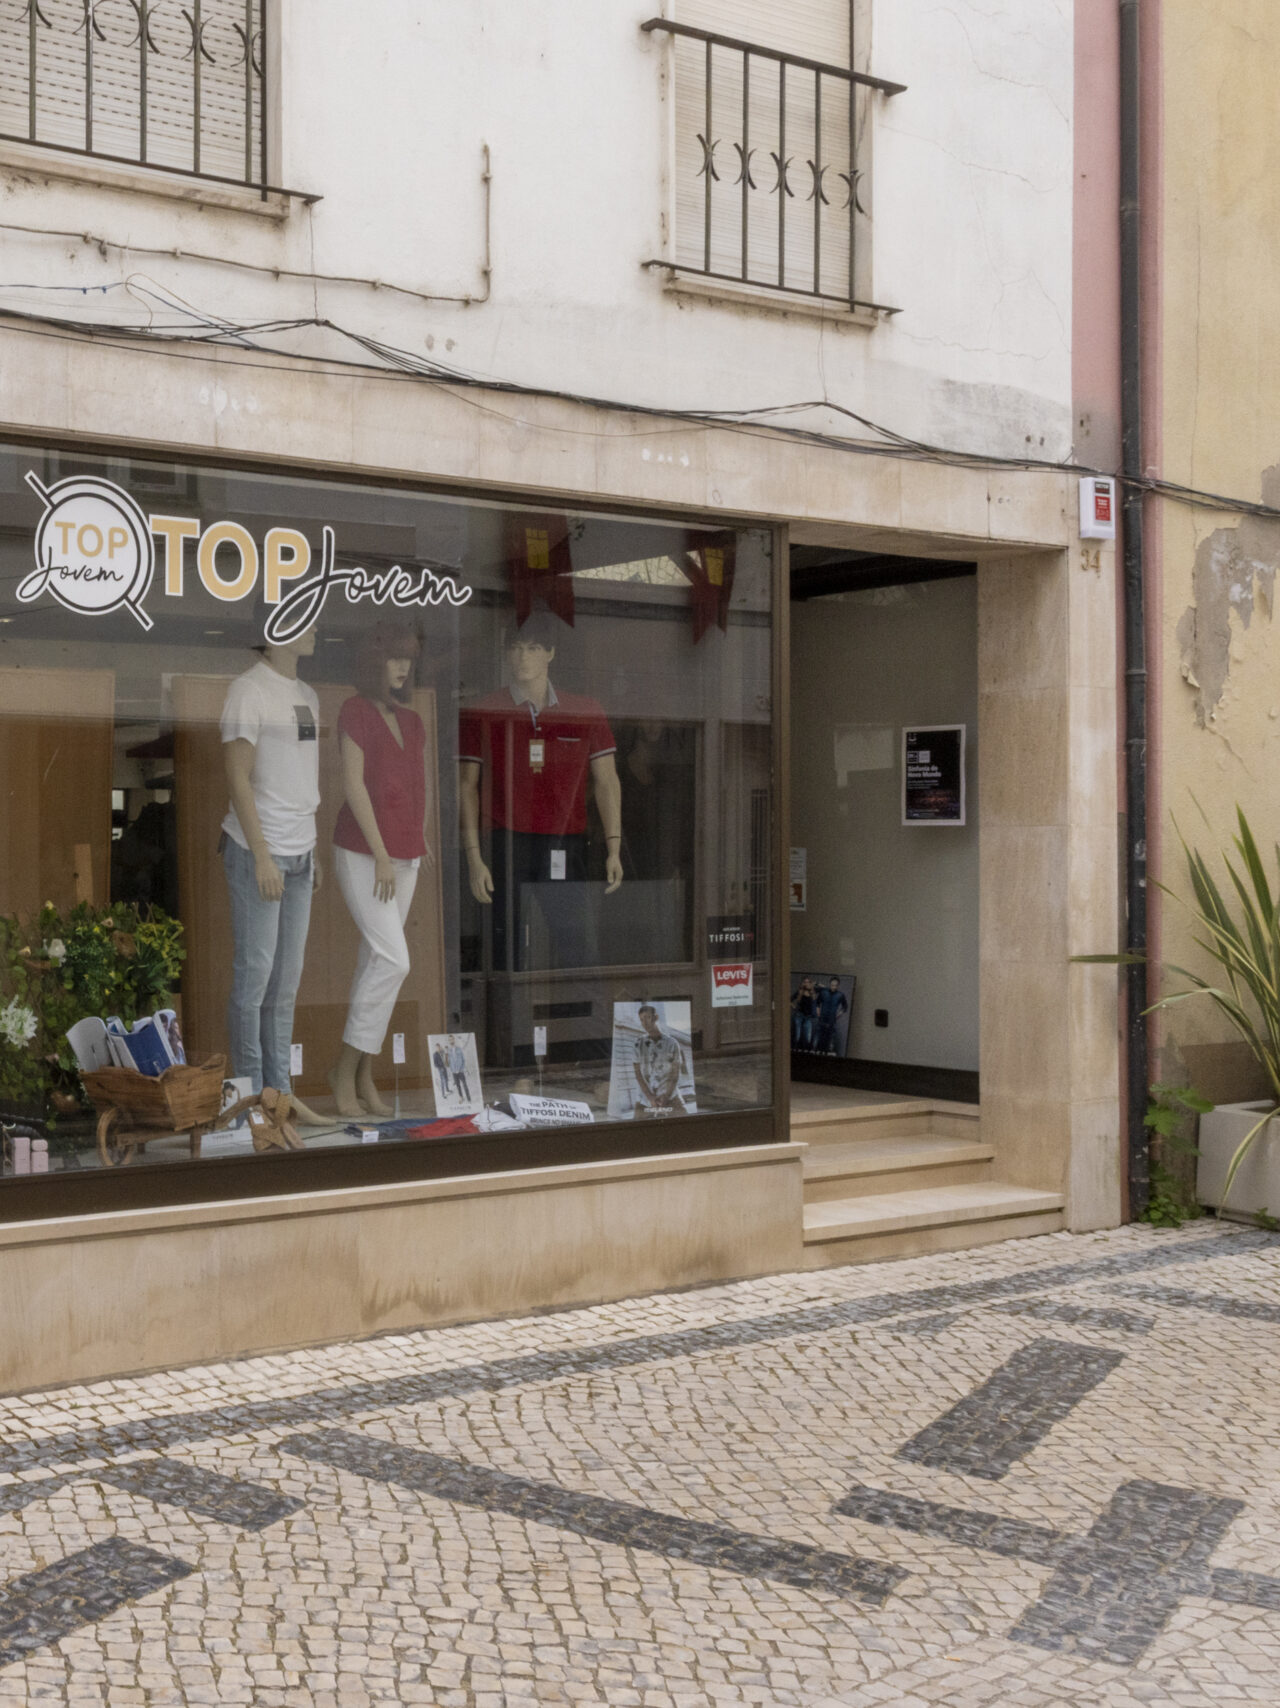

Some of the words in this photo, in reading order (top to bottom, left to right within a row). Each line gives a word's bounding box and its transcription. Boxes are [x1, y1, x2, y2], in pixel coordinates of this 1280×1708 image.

[54, 520, 129, 559] TOP
[17, 546, 125, 601] Jovem
[150, 515, 310, 604] TOP
[265, 526, 472, 645] Jovem
[708, 933, 745, 943] TIFFOSI
[520, 1107, 557, 1117] TIFFOSI
[559, 1110, 591, 1121] DENIM
[542, 1101, 568, 1109] PATH
